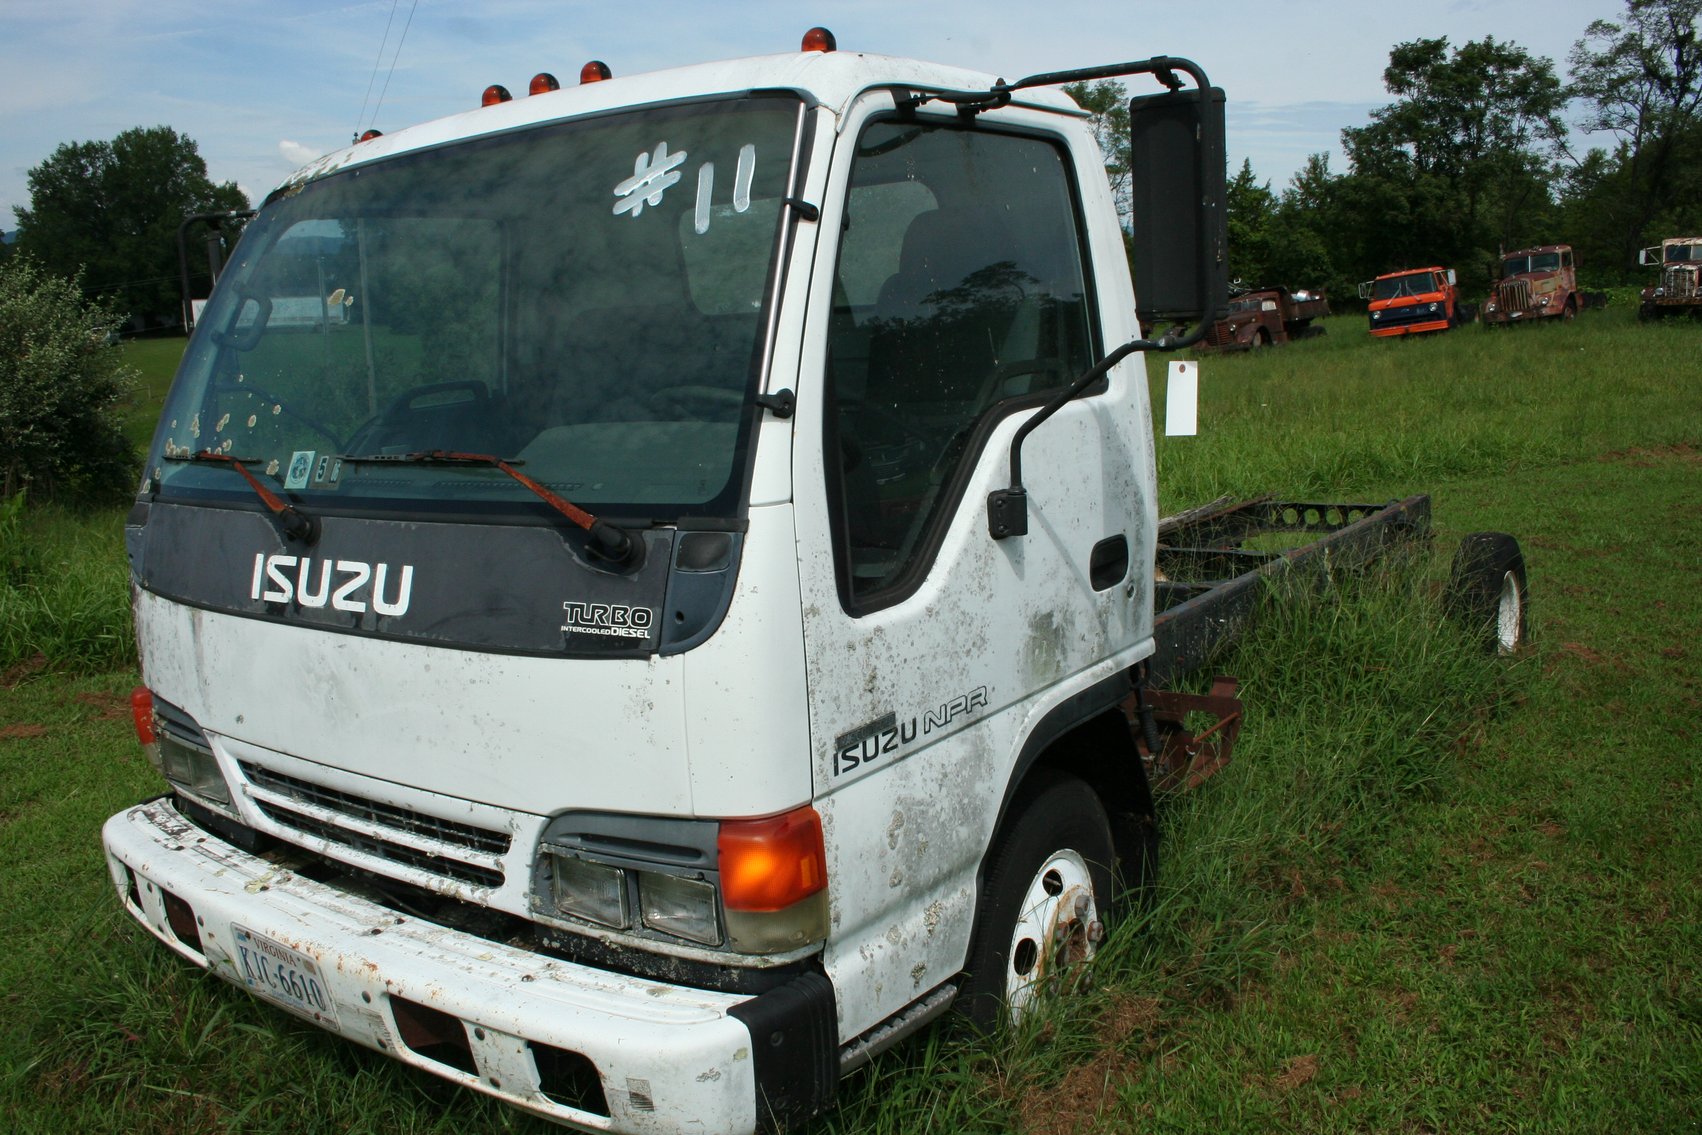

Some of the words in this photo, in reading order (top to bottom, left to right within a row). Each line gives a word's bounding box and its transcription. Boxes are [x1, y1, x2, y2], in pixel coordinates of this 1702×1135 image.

[612, 141, 756, 235] #11
[251, 553, 414, 616] ISUZU
[563, 602, 653, 629] TURBO
[833, 716, 917, 777] ISUZU
[923, 685, 988, 735] NPR
[253, 937, 297, 967] VIRGINIA
